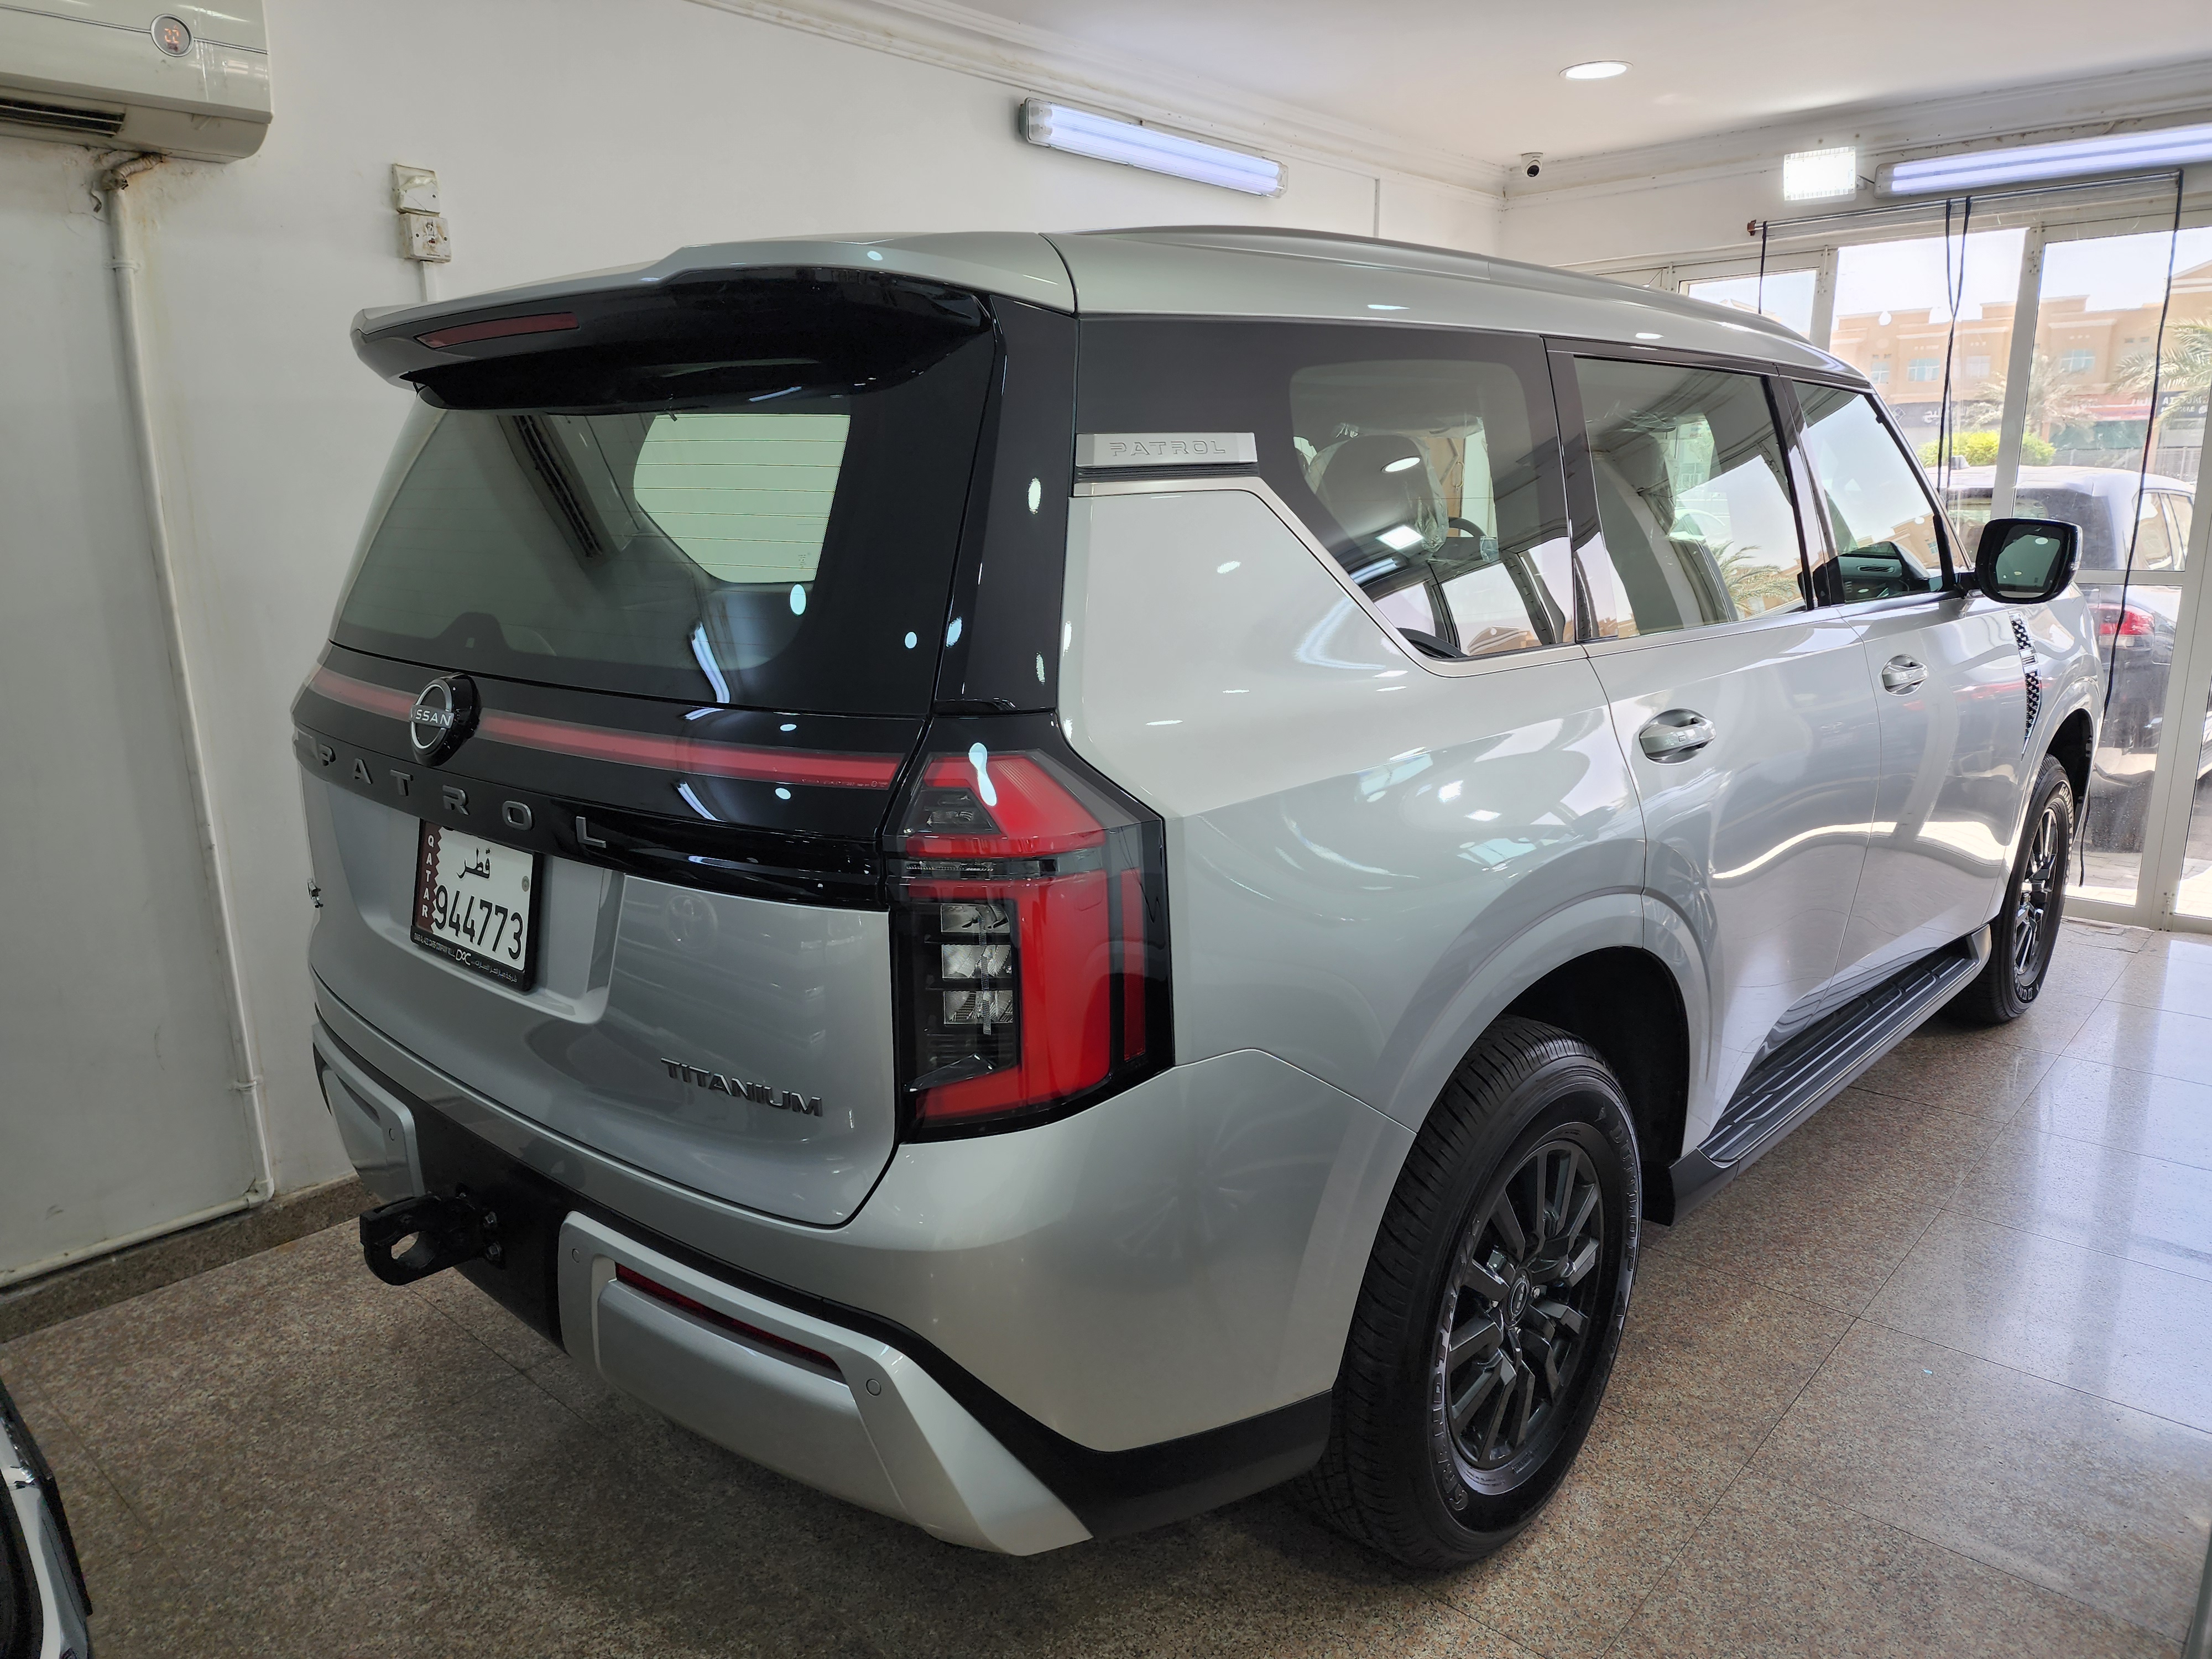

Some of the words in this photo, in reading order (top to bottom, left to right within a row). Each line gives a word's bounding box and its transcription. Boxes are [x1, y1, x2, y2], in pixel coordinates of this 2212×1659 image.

[1109, 440, 1226, 456] PATROL
[319, 743, 607, 848] PATROL
[421, 834, 435, 918] QATAR
[456, 847, 492, 879] قطر
[434, 884, 524, 961] 944773
[660, 1056, 823, 1118] TITANIUM
